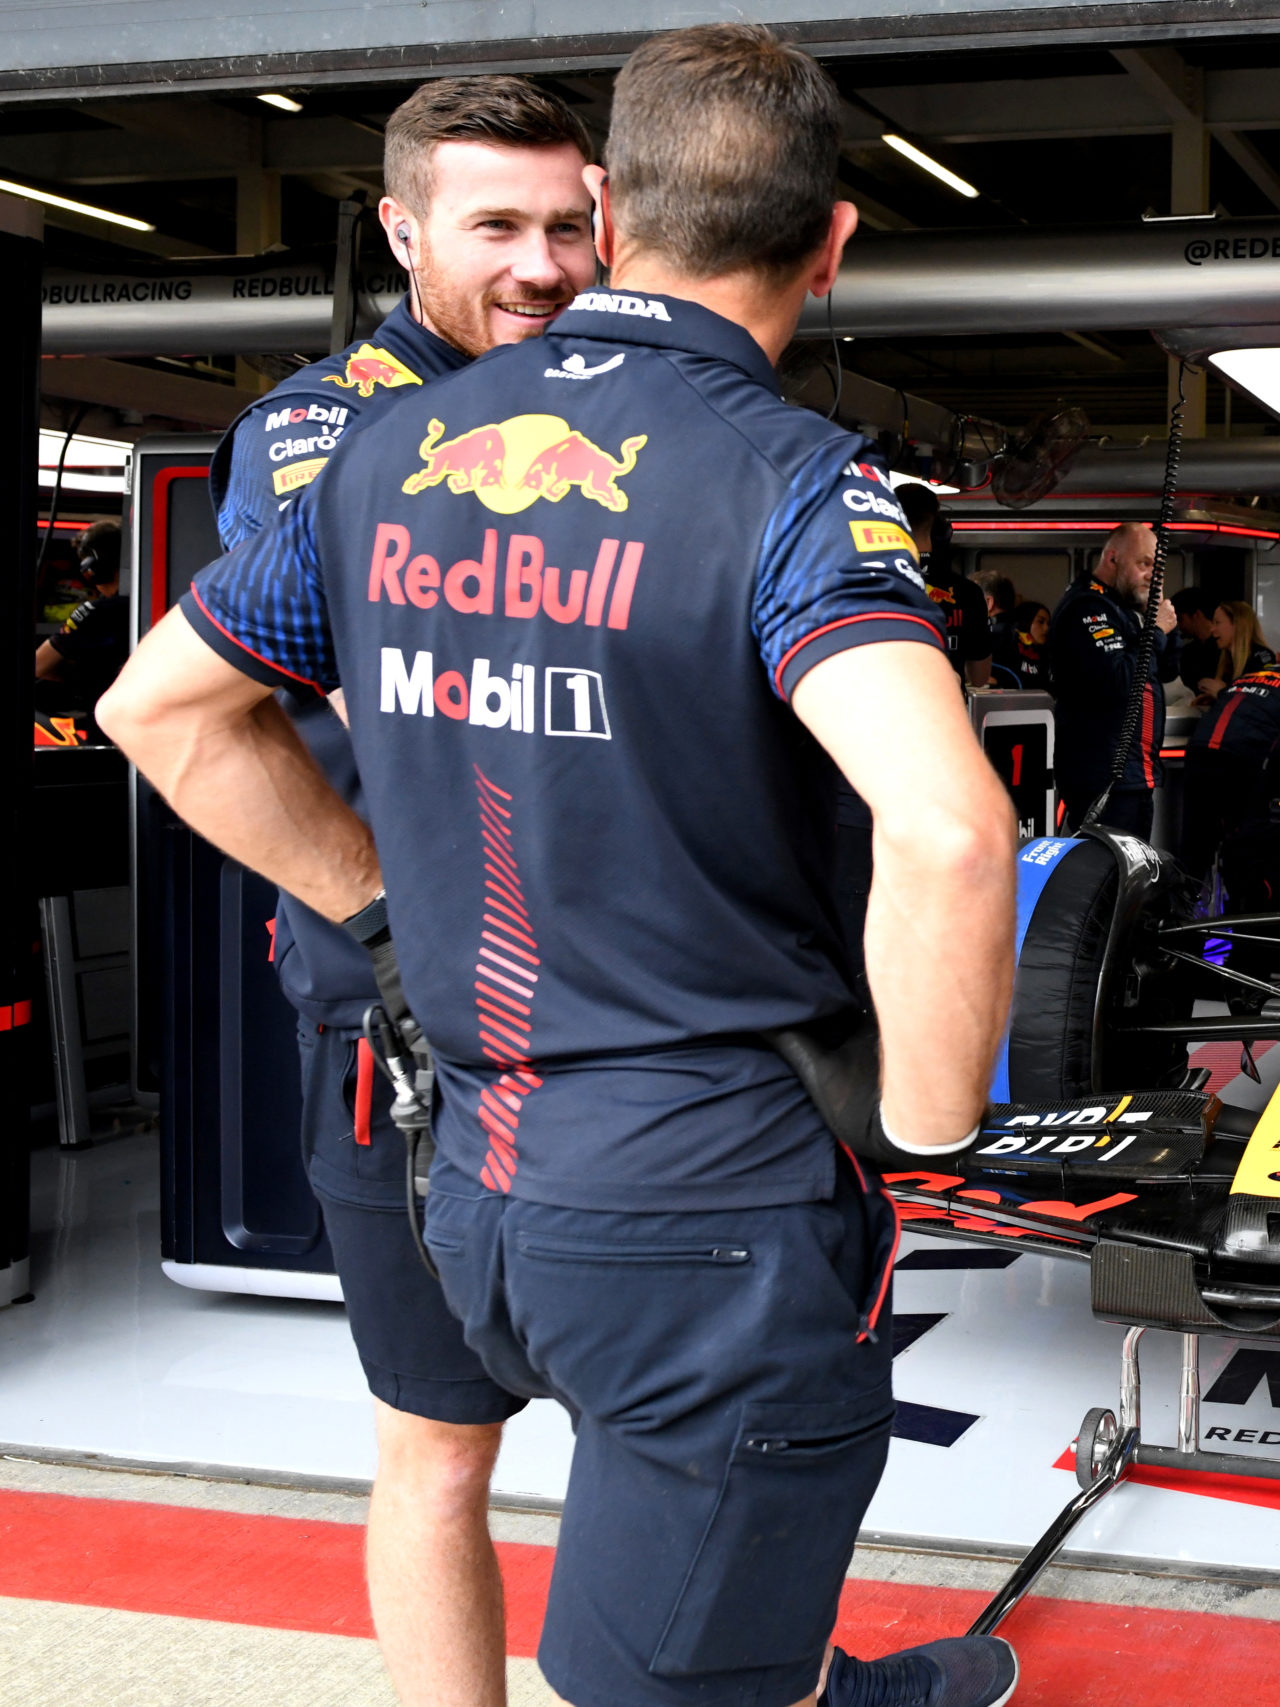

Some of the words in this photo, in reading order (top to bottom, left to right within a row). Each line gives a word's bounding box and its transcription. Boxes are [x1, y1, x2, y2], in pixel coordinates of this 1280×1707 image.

[265, 404, 348, 432] Mobil
[269, 433, 338, 462] Claro
[368, 523, 497, 609] Red
[504, 534, 644, 630] Bull
[380, 647, 535, 733] Mobil
